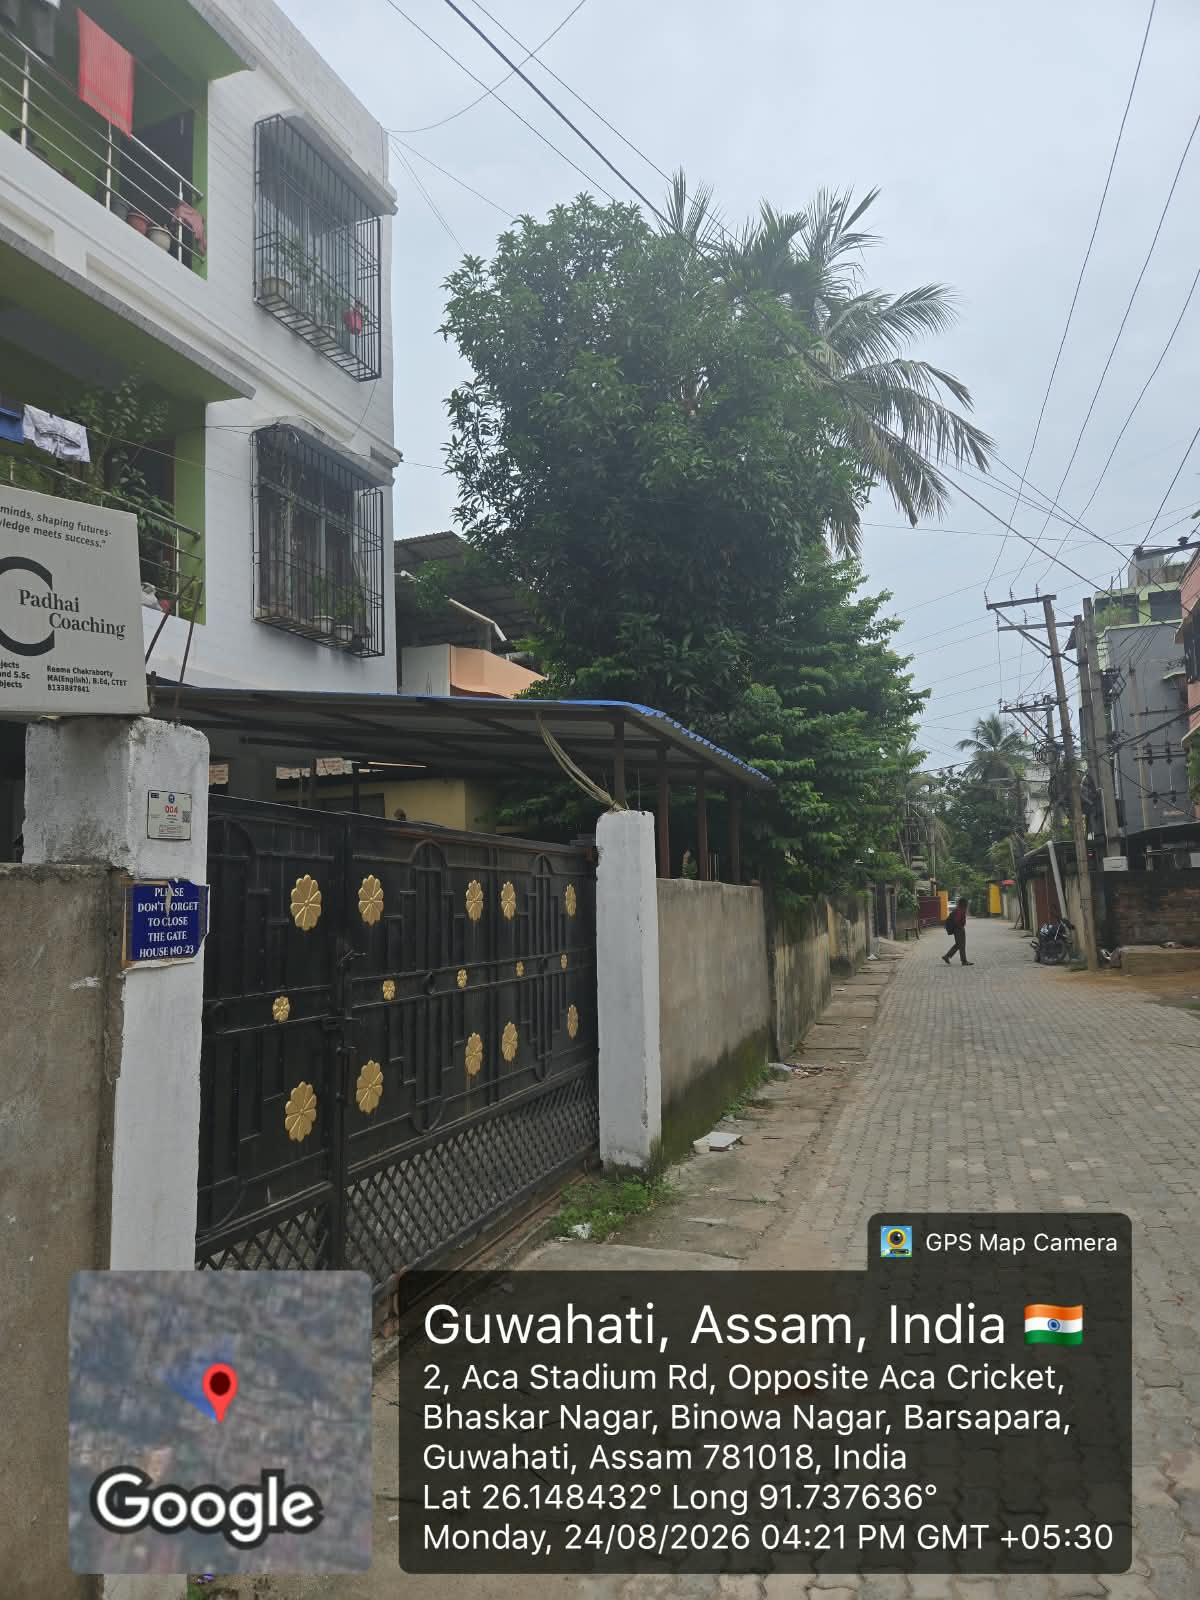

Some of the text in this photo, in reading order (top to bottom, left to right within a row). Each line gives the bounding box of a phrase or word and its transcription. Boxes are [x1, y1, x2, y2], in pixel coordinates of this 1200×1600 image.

[0, 506, 34, 521] minds,
[37, 513, 75, 530] shaping
[33, 526, 62, 540] meets
[19, 588, 80, 612] Padhai
[49, 612, 126, 640] Coaching
[137, 901, 199, 913] DON'T ORGET
[147, 916, 189, 927] TO CLOSE
[147, 930, 188, 943] THE GATE
[139, 945, 194, 958] HOUSE NO-23
